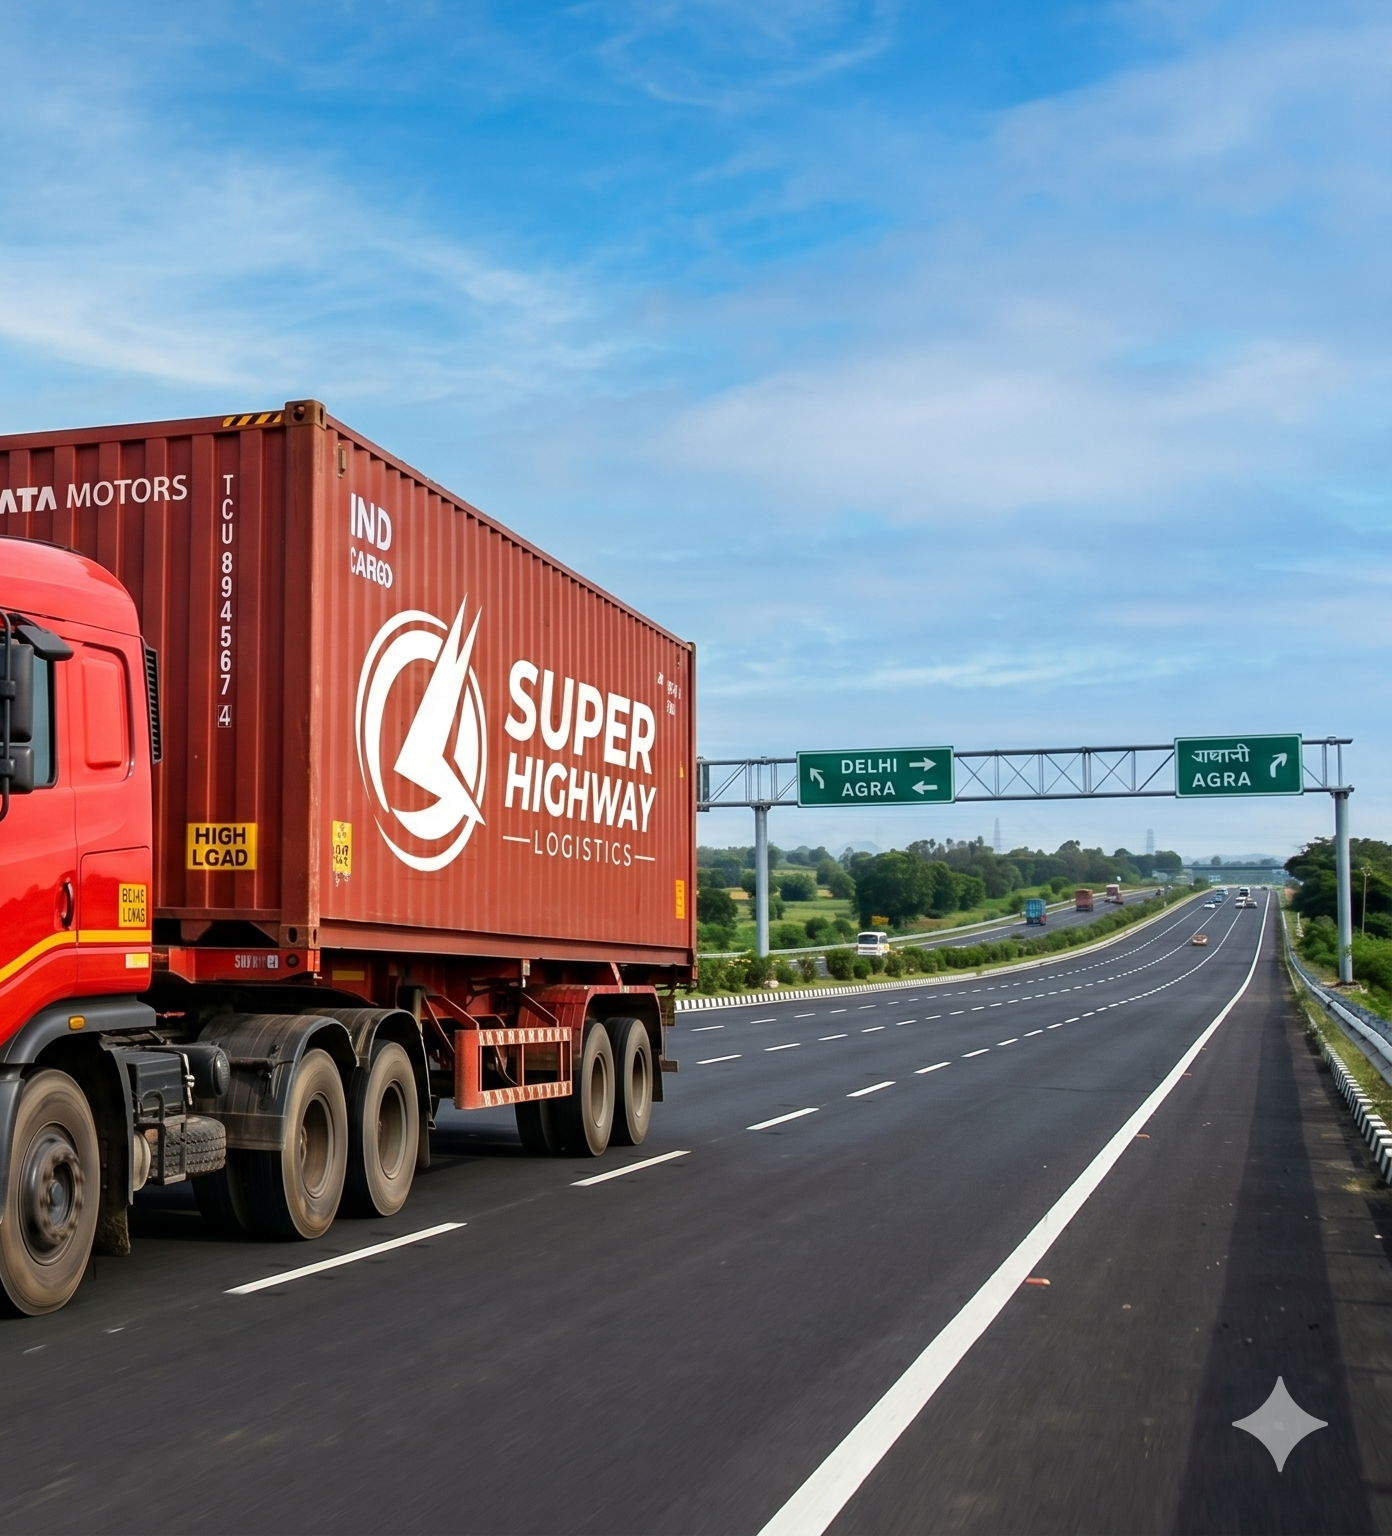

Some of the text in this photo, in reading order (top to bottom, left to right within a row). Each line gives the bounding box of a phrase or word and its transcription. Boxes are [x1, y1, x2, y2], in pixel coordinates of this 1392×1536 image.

[66, 474, 188, 509] MOTORS
[350, 492, 392, 552] IND
[350, 546, 393, 589] CARGO
[504, 659, 656, 775] SUPER
[841, 758, 897, 774] DELHI
[1192, 771, 1251, 788] AGRA
[504, 752, 657, 833] HIGHWAY
[841, 781, 896, 797] AGRA
[195, 827, 246, 845] HIGH
[534, 830, 632, 867] LOGISTICS
